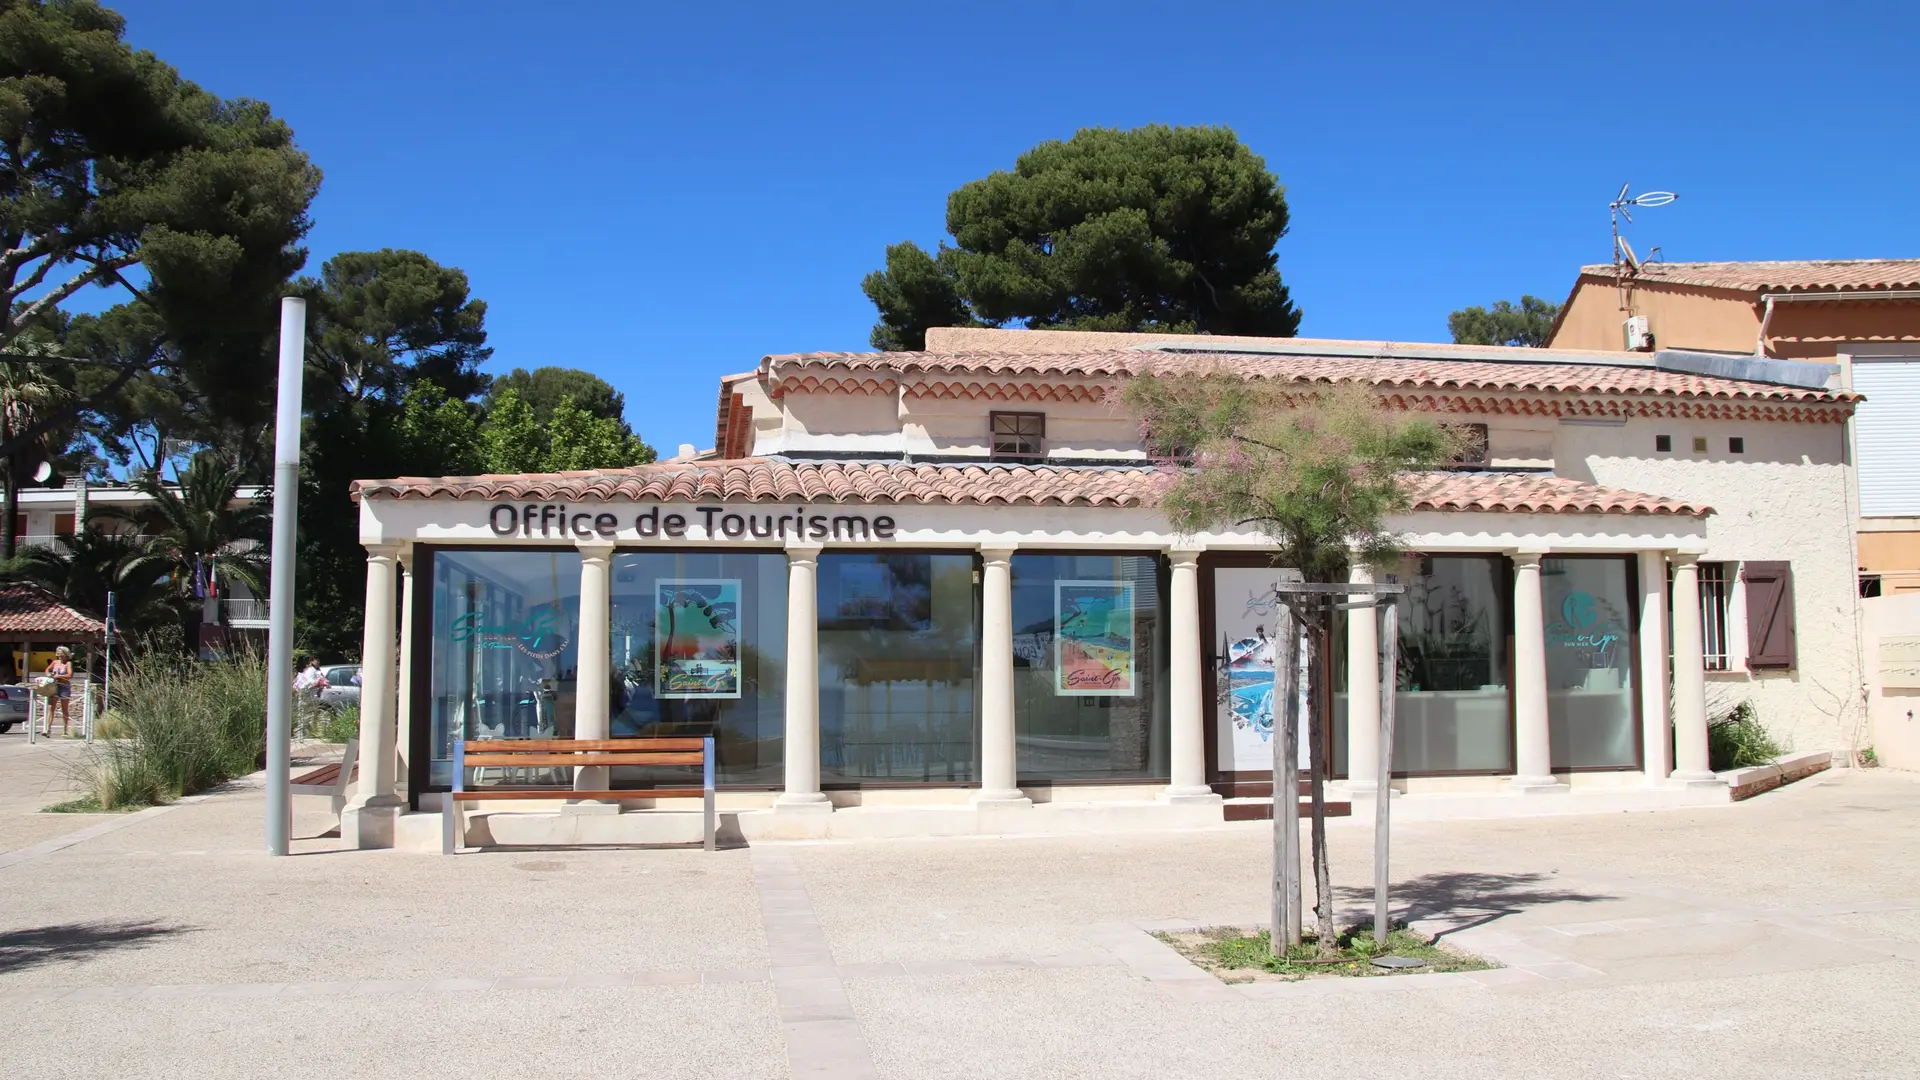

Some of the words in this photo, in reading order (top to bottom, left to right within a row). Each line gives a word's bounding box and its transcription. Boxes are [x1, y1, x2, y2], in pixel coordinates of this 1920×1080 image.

[490, 504, 618, 536] Office
[636, 506, 686, 536] de
[696, 507, 896, 538] Tourisme
